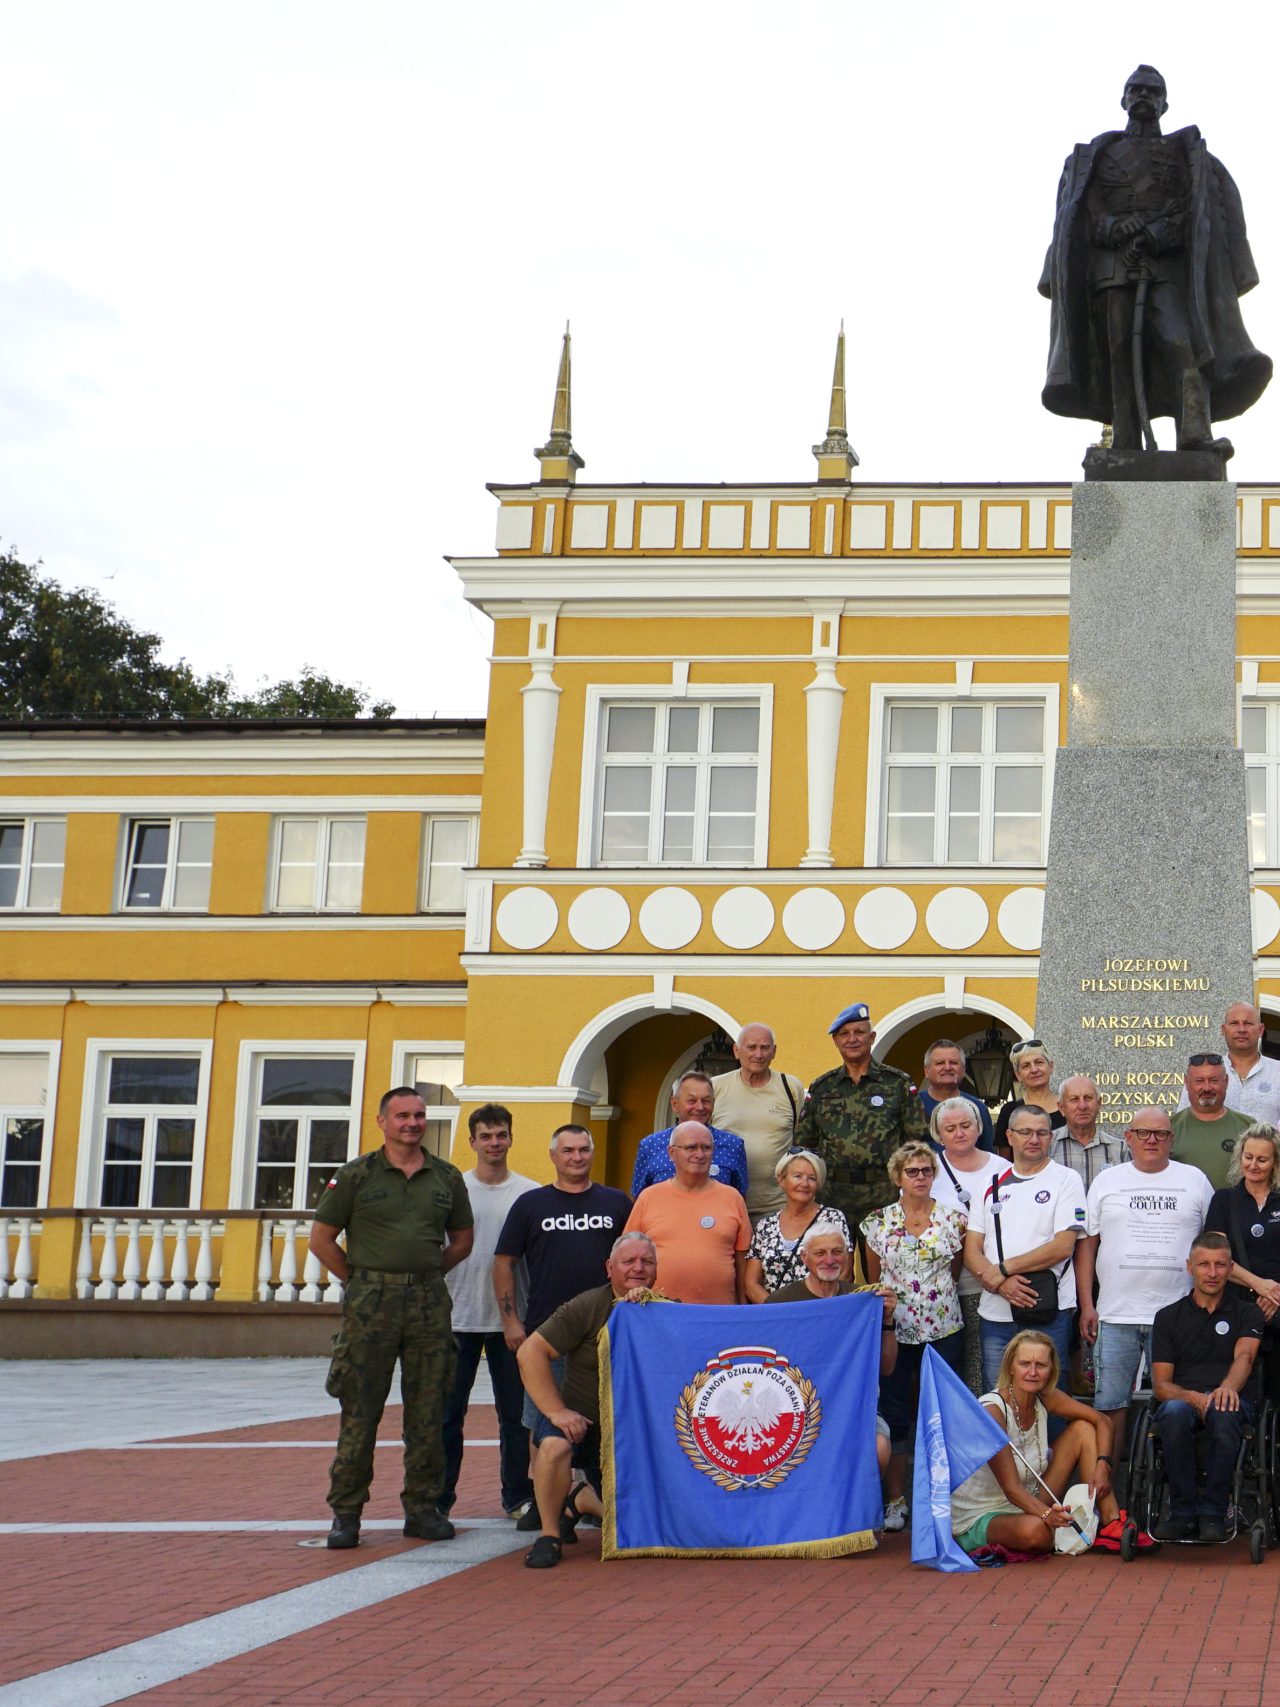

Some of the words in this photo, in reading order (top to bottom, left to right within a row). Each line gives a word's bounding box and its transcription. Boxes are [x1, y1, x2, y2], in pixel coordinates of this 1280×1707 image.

[1104, 958, 1189, 972] JÓZEFOWI
[1081, 978, 1211, 992] PIŁSUDSKIEMU
[1081, 1016, 1210, 1029] MARSZAŁKOWI
[1114, 1034, 1175, 1048] POLSKI
[1095, 1072, 1120, 1086] 100
[1126, 1072, 1185, 1086] ROCZN
[1100, 1091, 1180, 1105] DZYSKAN
[1129, 1201, 1178, 1211] COUTURE
[541, 1213, 614, 1232] adidas
[765, 1370, 787, 1387] POZA
